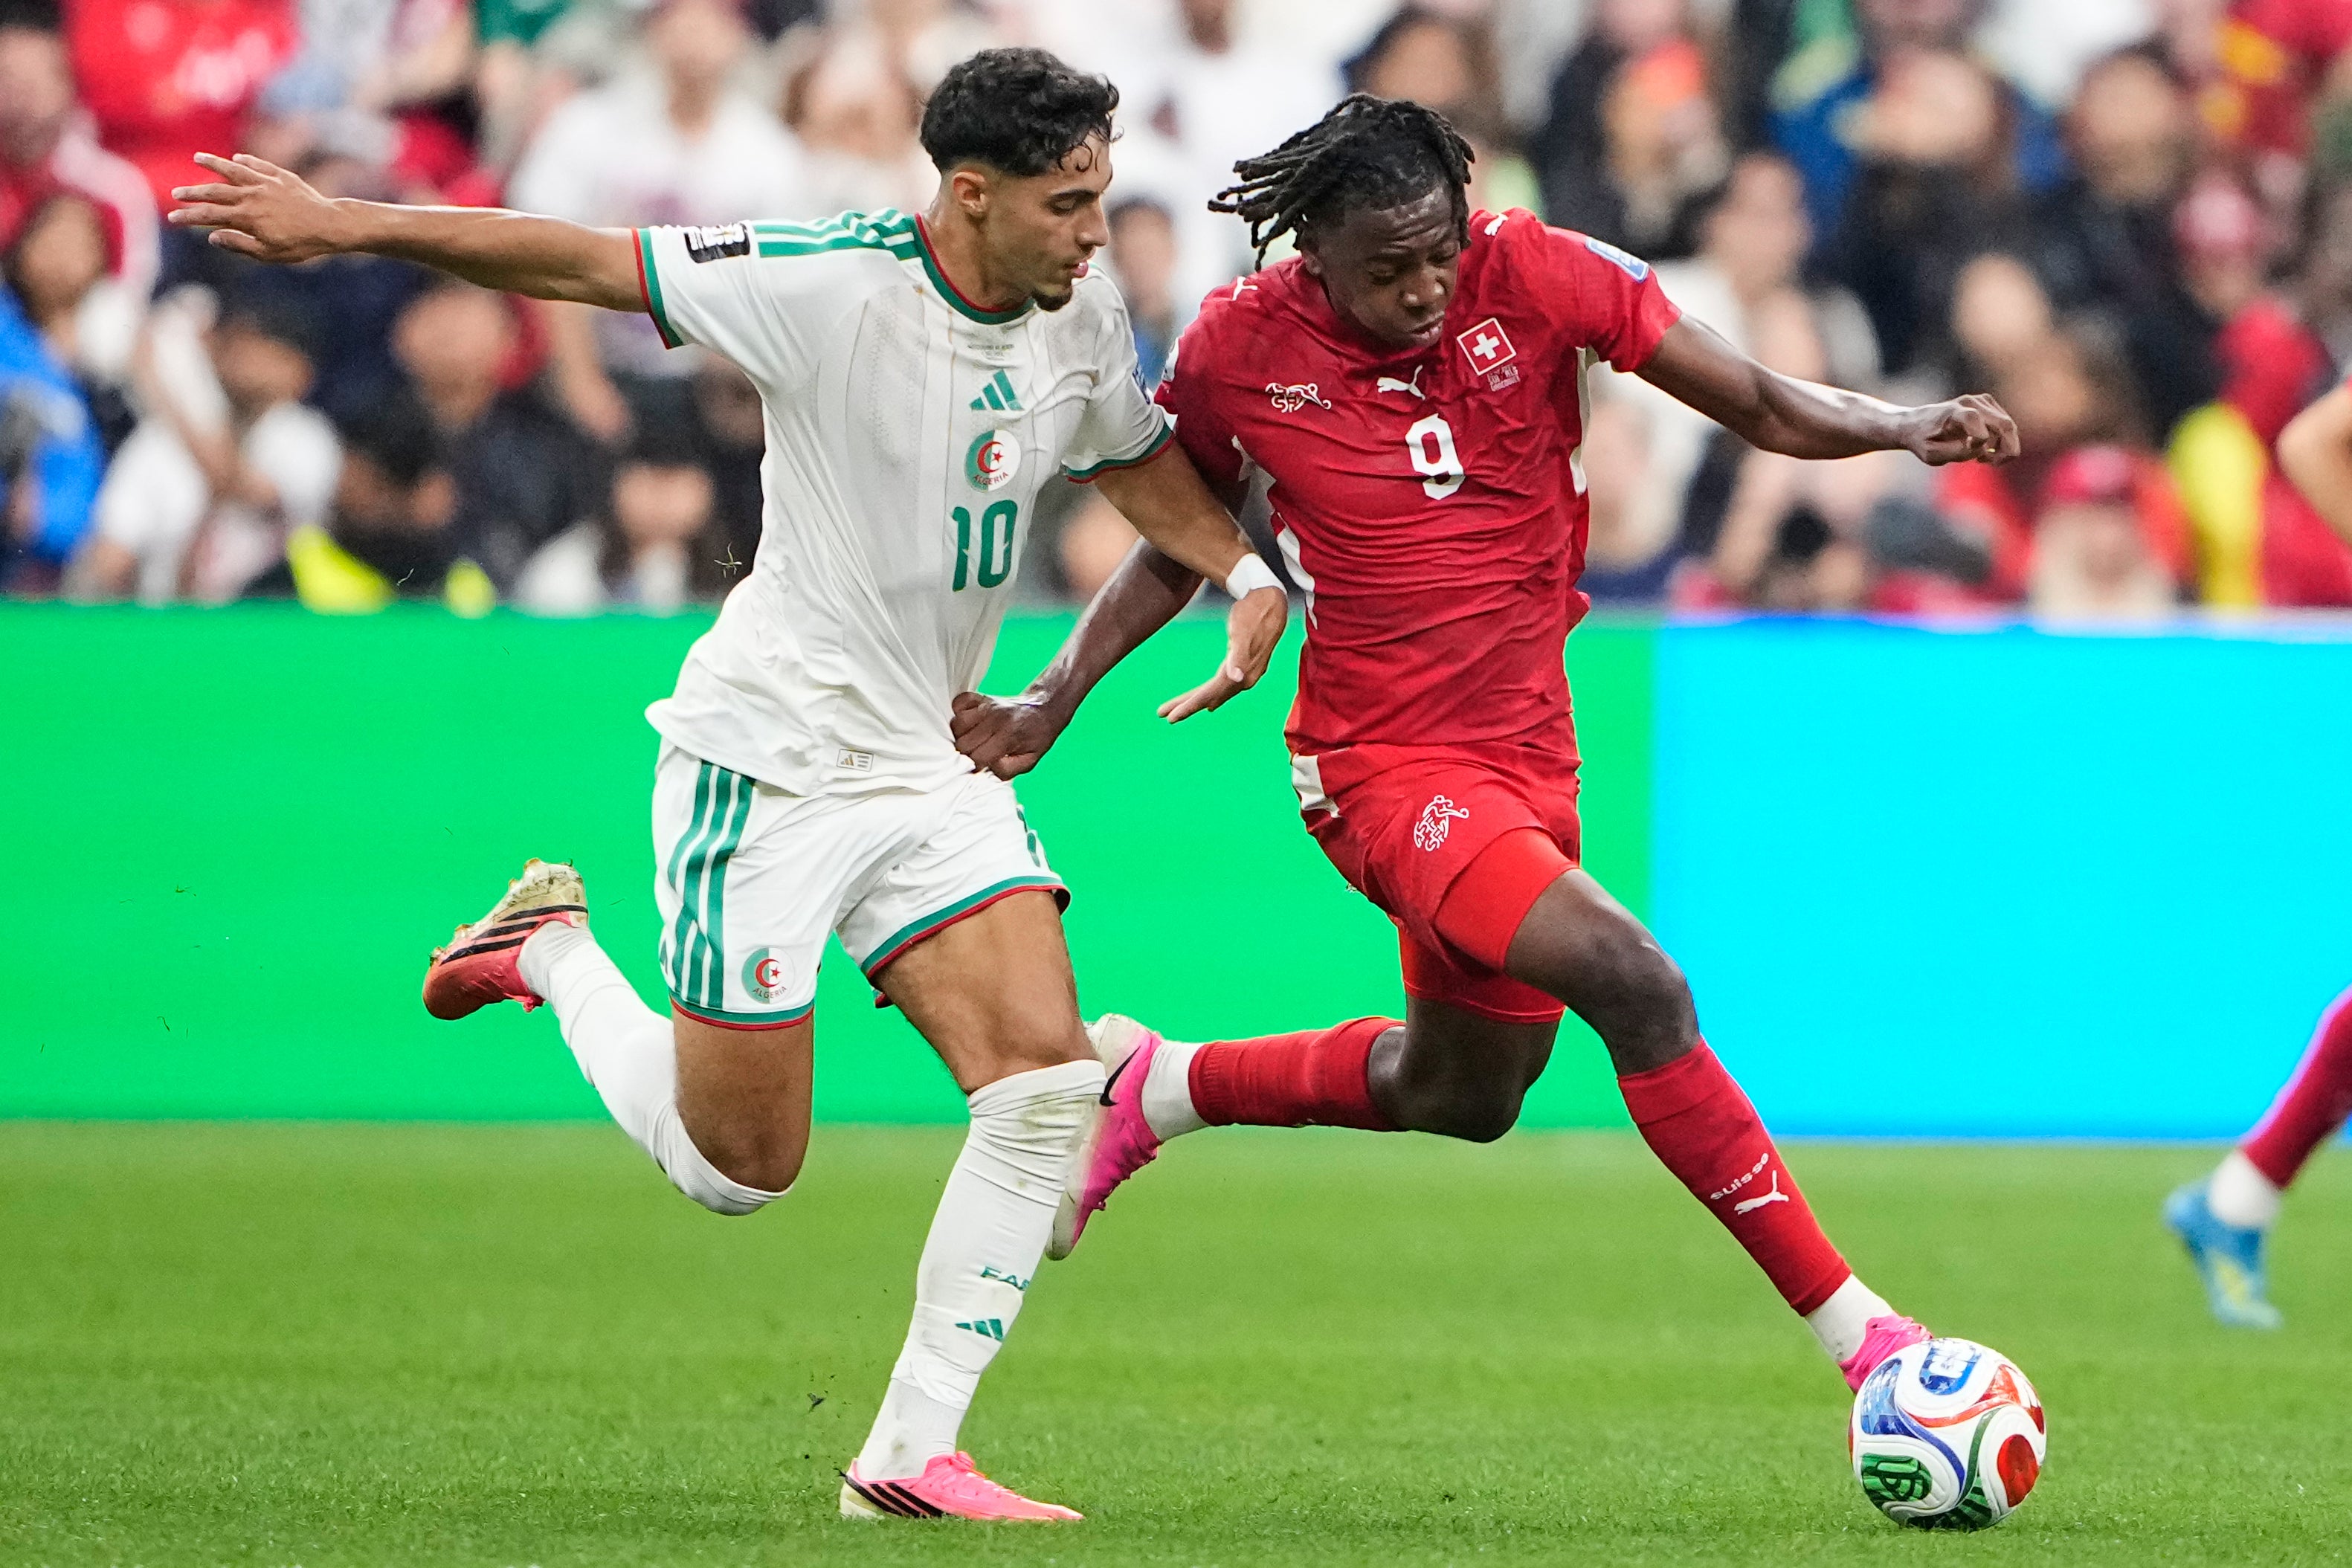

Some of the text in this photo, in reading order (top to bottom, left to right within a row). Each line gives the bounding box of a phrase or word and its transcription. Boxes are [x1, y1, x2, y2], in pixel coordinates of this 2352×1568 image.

[973, 472, 1009, 485] ALGERIA
[1405, 413, 1466, 500] 9
[952, 500, 1018, 592] 10
[753, 986, 787, 999] ALGERIA
[1710, 1153, 1769, 1200] suisse
